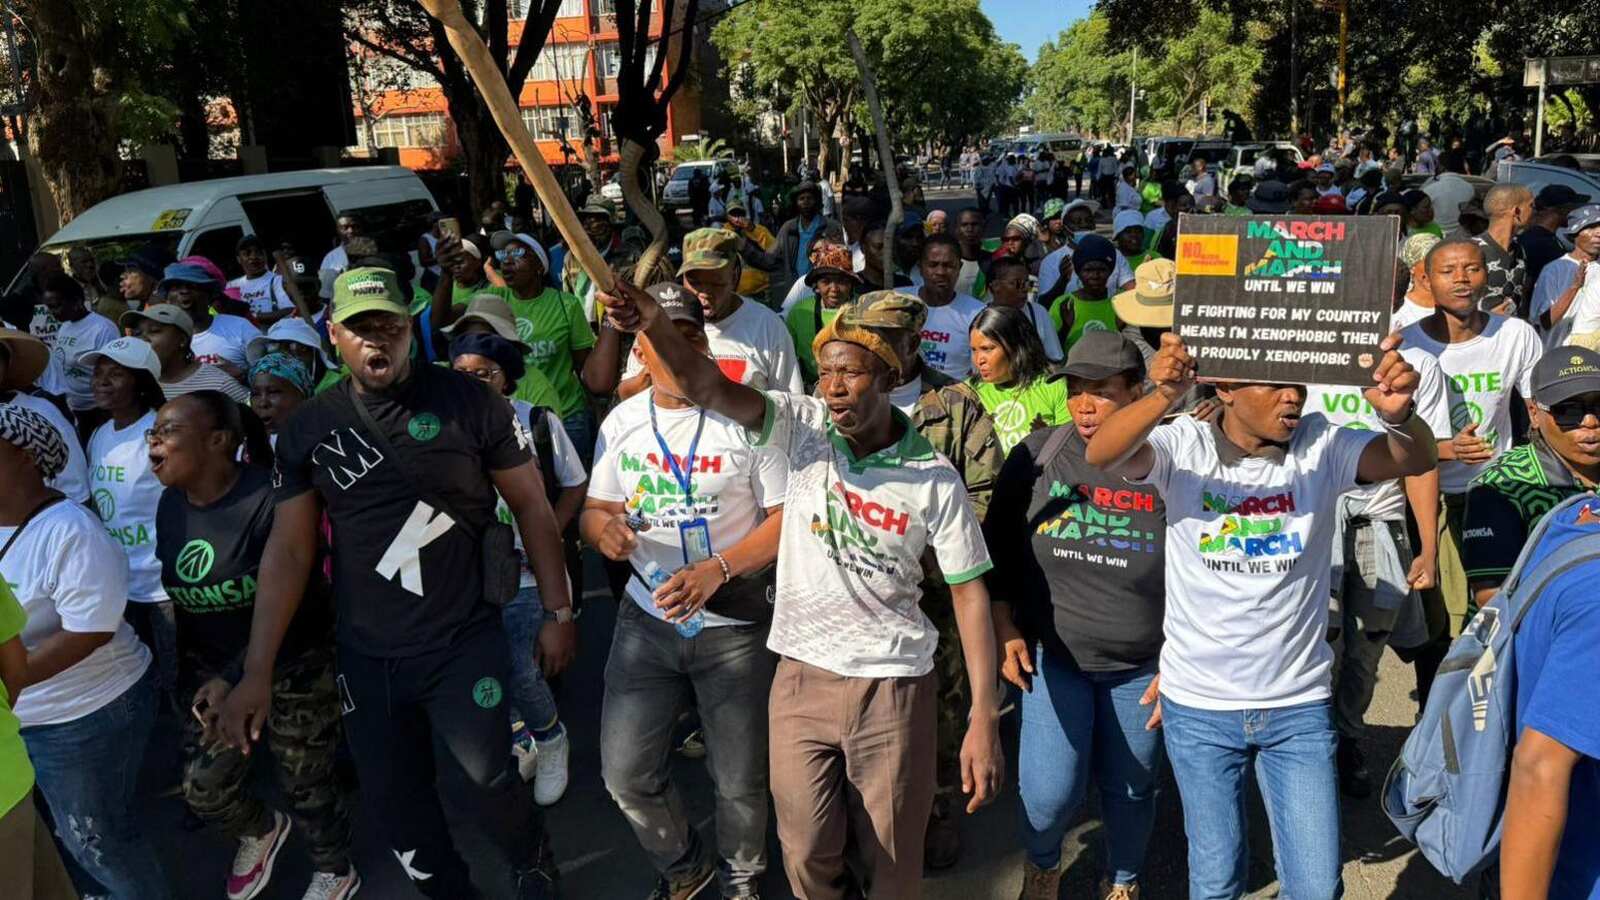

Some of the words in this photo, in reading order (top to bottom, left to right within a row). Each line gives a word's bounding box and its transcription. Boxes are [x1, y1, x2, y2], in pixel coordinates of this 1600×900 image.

[1247, 220, 1345, 240] MARCH
[1264, 240, 1324, 259] AND
[1244, 259, 1343, 279] MARCH
[1244, 280, 1282, 292] UNTIL
[1286, 281, 1307, 293] WE
[1310, 282, 1335, 294] WIN
[1181, 304, 1194, 316] IF
[1197, 305, 1256, 319] FIGHTING
[1260, 307, 1287, 320] FOR
[1291, 308, 1312, 321] MY
[1316, 309, 1381, 324] COUNTRY
[1180, 325, 1226, 339] MEANS
[1229, 326, 1248, 339] I'M
[1251, 327, 1337, 343] XENOPHOBIC
[1341, 331, 1380, 345] THEN
[1200, 346, 1260, 361] PROUDLY
[1265, 350, 1351, 365] XENOPHOBIC
[1451, 372, 1501, 393] OTE
[1321, 392, 1375, 415] VOT
[1202, 488, 1296, 517] MARCH
[662, 519, 676, 529] WE
[1060, 503, 1131, 528] AND
[1220, 515, 1282, 537] AND
[375, 499, 456, 598] K
[1199, 531, 1303, 557] MARCH
[1053, 547, 1084, 561] UNTIL
[1086, 552, 1103, 564] WE
[1105, 556, 1128, 568] WIN
[1247, 560, 1271, 574] WE
